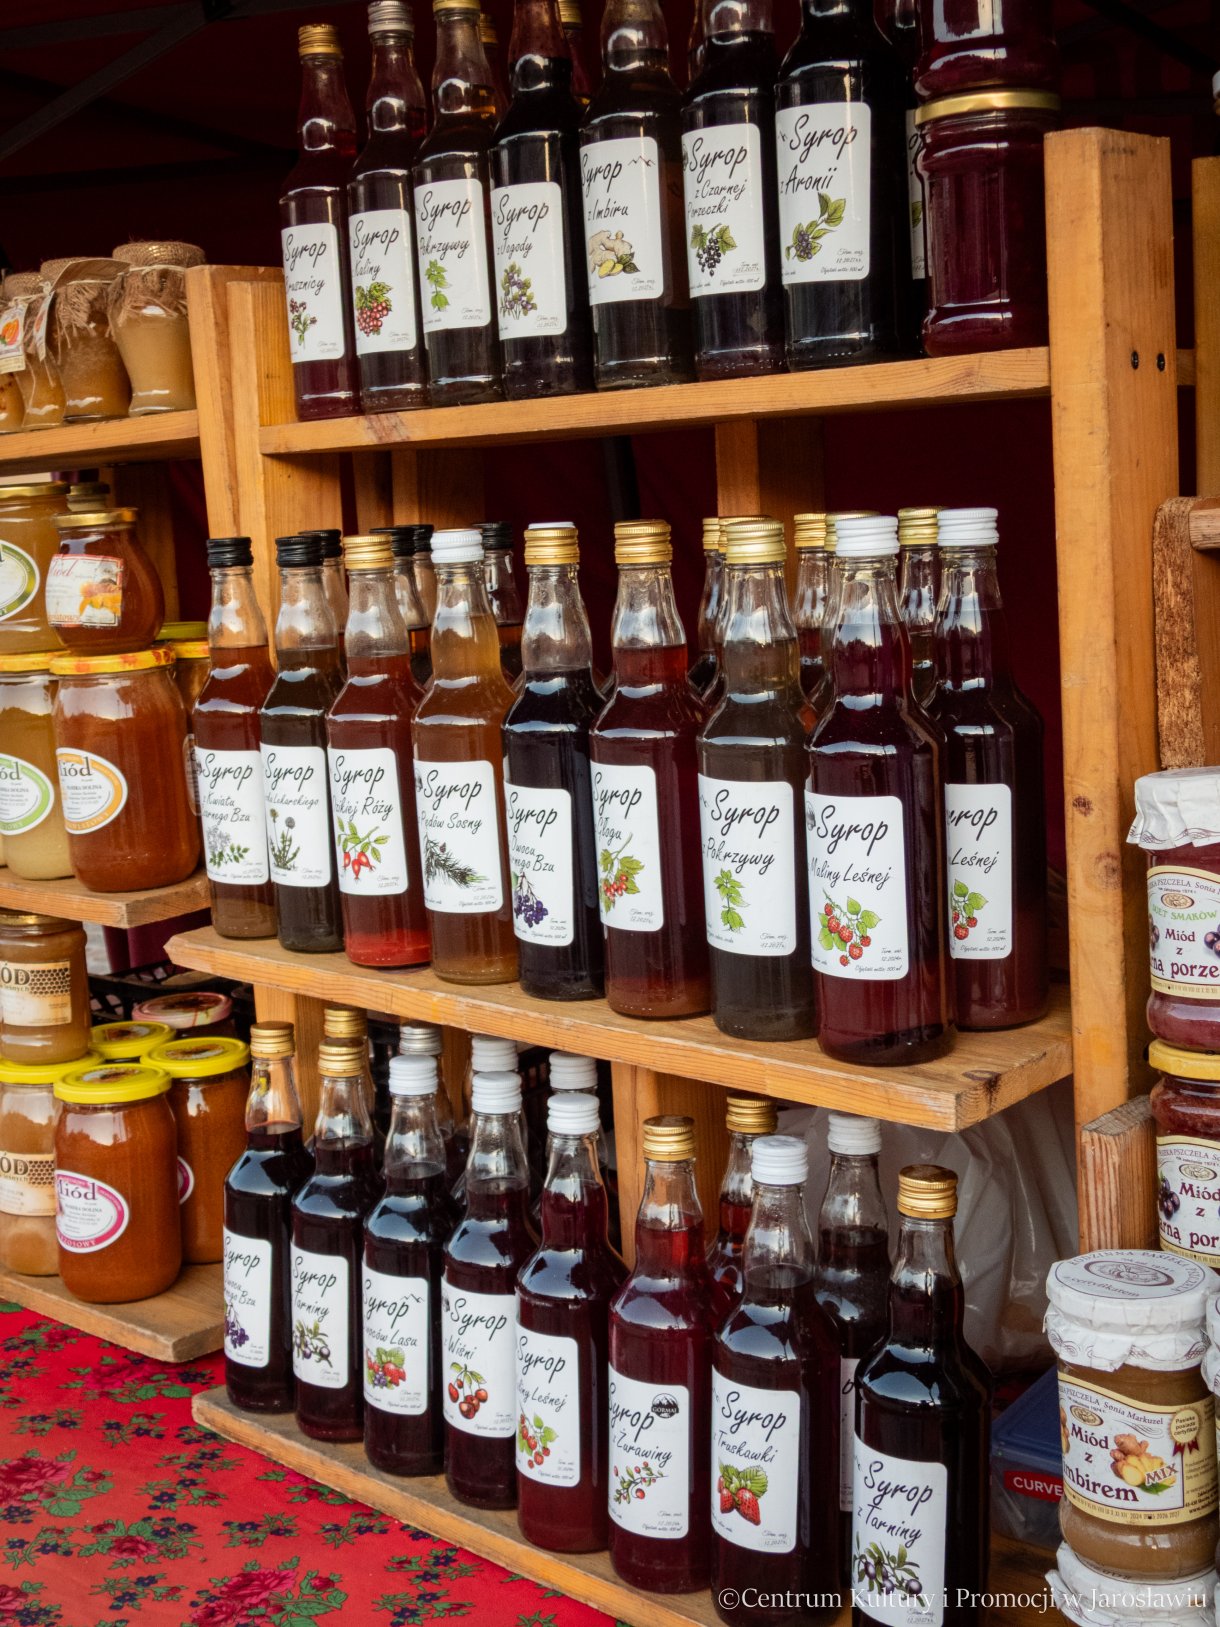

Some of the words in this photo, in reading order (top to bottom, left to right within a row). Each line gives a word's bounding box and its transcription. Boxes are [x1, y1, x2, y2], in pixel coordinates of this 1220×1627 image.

[789, 113, 858, 163] Syrop
[581, 153, 622, 198] Syrop
[689, 137, 748, 184] Syrop
[785, 164, 838, 195] Aronii
[701, 179, 748, 200] Czarnej
[420, 190, 472, 232] Syrop
[496, 193, 550, 236] Syrop
[592, 198, 629, 220] Imbiru
[284, 233, 327, 271] Syrop
[353, 219, 399, 259] Syrop
[203, 752, 253, 791] Syrop
[265, 752, 314, 792] Syrop
[333, 755, 385, 795] Syrop
[423, 769, 482, 811] Syrop
[361, 796, 393, 822] Róży
[507, 791, 558, 837] Syrop
[593, 771, 643, 819] Syrop
[710, 789, 780, 839] Syrop
[230, 808, 250, 822] Bzu
[447, 812, 482, 834] Sosny
[816, 804, 889, 856] Syrop
[946, 807, 998, 841] yrop
[532, 854, 555, 872] Bzu
[706, 837, 775, 875] Pokrzywy
[950, 847, 1000, 874] Leśnej
[843, 863, 892, 890] Leśnej
[1156, 877, 1191, 887] PSZCZELA
[1195, 881, 1216, 893] Sonia
[1164, 928, 1196, 942] Miód
[1176, 946, 1183, 955] z
[1173, 1148, 1209, 1160] PSZCZELA
[1195, 1207, 1206, 1217] z
[223, 1236, 260, 1277] Syrop
[293, 1256, 337, 1298] Syrop
[294, 1288, 330, 1323] Tarniny
[363, 1279, 409, 1329] Syrop
[450, 1298, 507, 1341] Syrop
[390, 1329, 418, 1346] Lasu
[517, 1335, 566, 1384] Syrop
[532, 1386, 569, 1412] Leśnej
[608, 1382, 654, 1442] Syrop
[721, 1391, 787, 1443] Syrop
[1103, 1401, 1125, 1416] Sonia
[1126, 1410, 1164, 1425] Markuzel
[616, 1428, 672, 1468] Żurawiny
[718, 1430, 779, 1463] Truskawki
[1071, 1423, 1110, 1450] Miód
[1084, 1451, 1093, 1464] z
[1145, 1463, 1179, 1486] MIX
[864, 1460, 933, 1516] Syrop
[1013, 1476, 1064, 1497] CURVE
[857, 1506, 864, 1517] z
[865, 1503, 922, 1549] Tarniny
